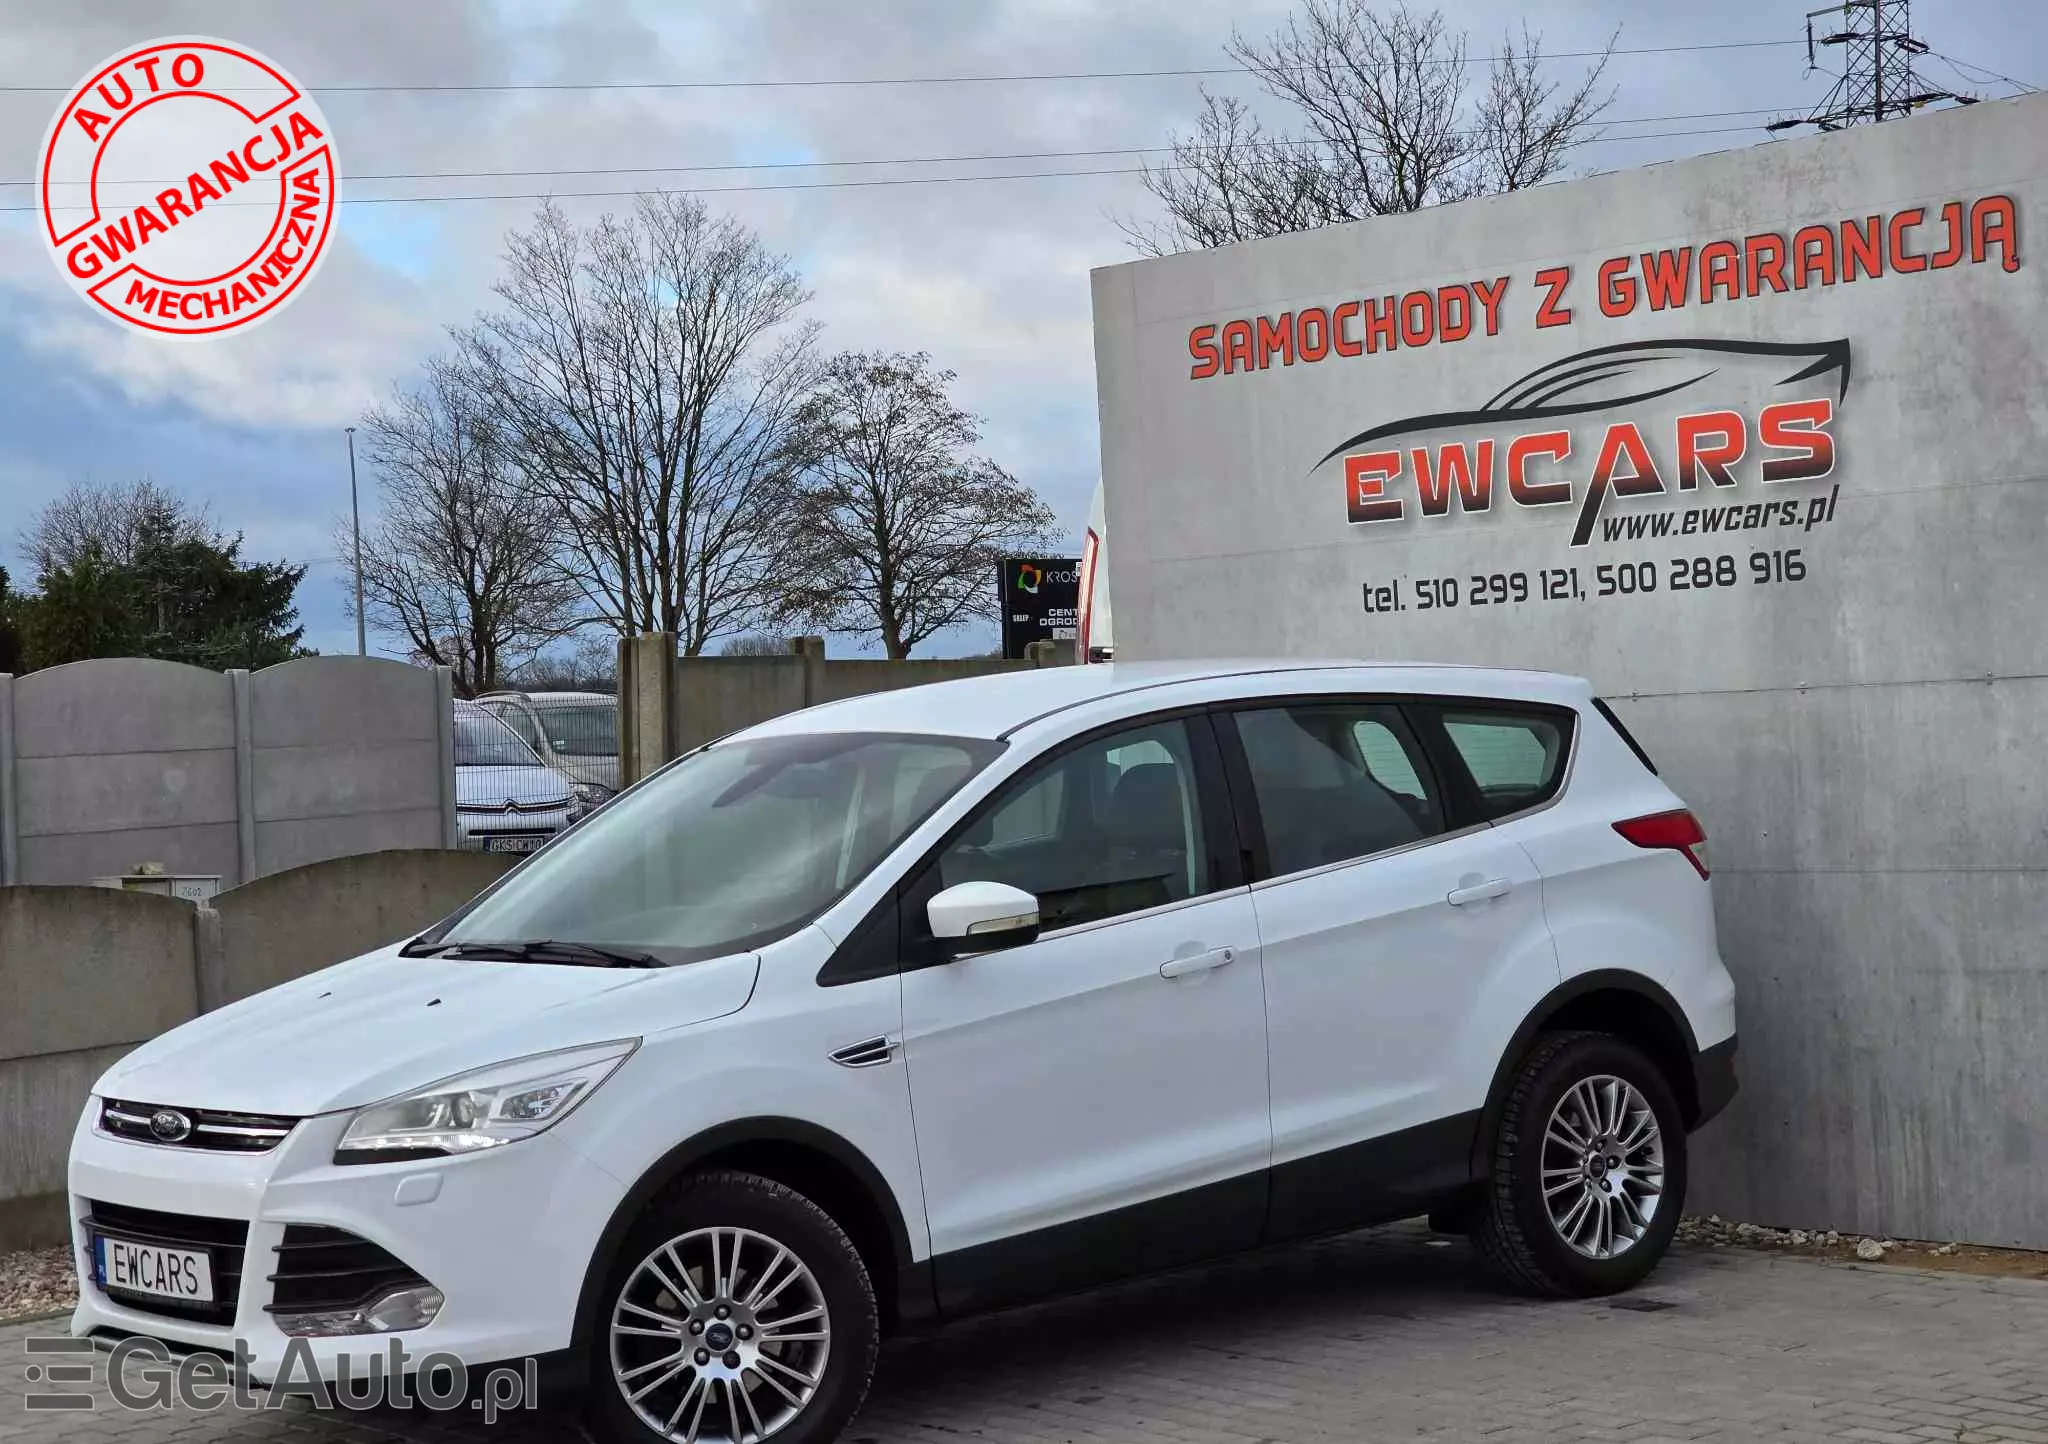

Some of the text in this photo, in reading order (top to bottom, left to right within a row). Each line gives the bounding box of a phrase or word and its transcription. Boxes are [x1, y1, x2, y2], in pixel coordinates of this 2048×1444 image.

[1189, 195, 2021, 380] SAMOCHODY Z GWARANCJĄ
[1343, 398, 1836, 548] EWCARS
[1602, 484, 1840, 543] www.ewcars.pl
[1363, 548, 1807, 613] tel. 510 299 121, 500 288 916
[113, 1243, 198, 1295] EWCARS
